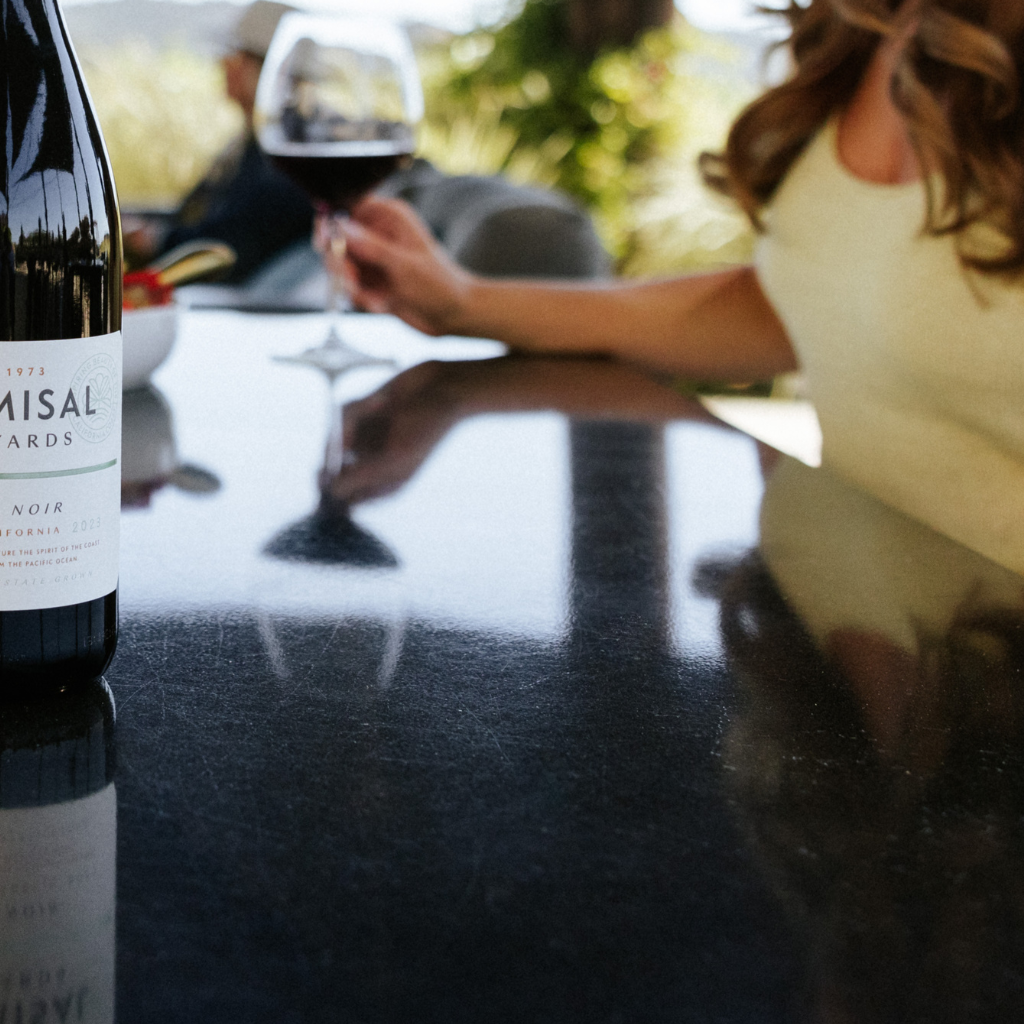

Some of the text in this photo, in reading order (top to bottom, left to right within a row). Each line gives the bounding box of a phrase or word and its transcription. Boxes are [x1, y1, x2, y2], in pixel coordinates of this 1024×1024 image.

[7, 367, 45, 376] 1973
[11, 501, 63, 516] NOIR
[72, 517, 101, 533] 2023
[36, 546, 58, 555] SPIRIT
[60, 545, 69, 553] OF
[71, 543, 82, 551] THE
[83, 539, 100, 549] COAST
[25, 558, 53, 567] PACIFIC
[56, 556, 78, 565] OCEAN
[54, 570, 93, 583] GROWN
